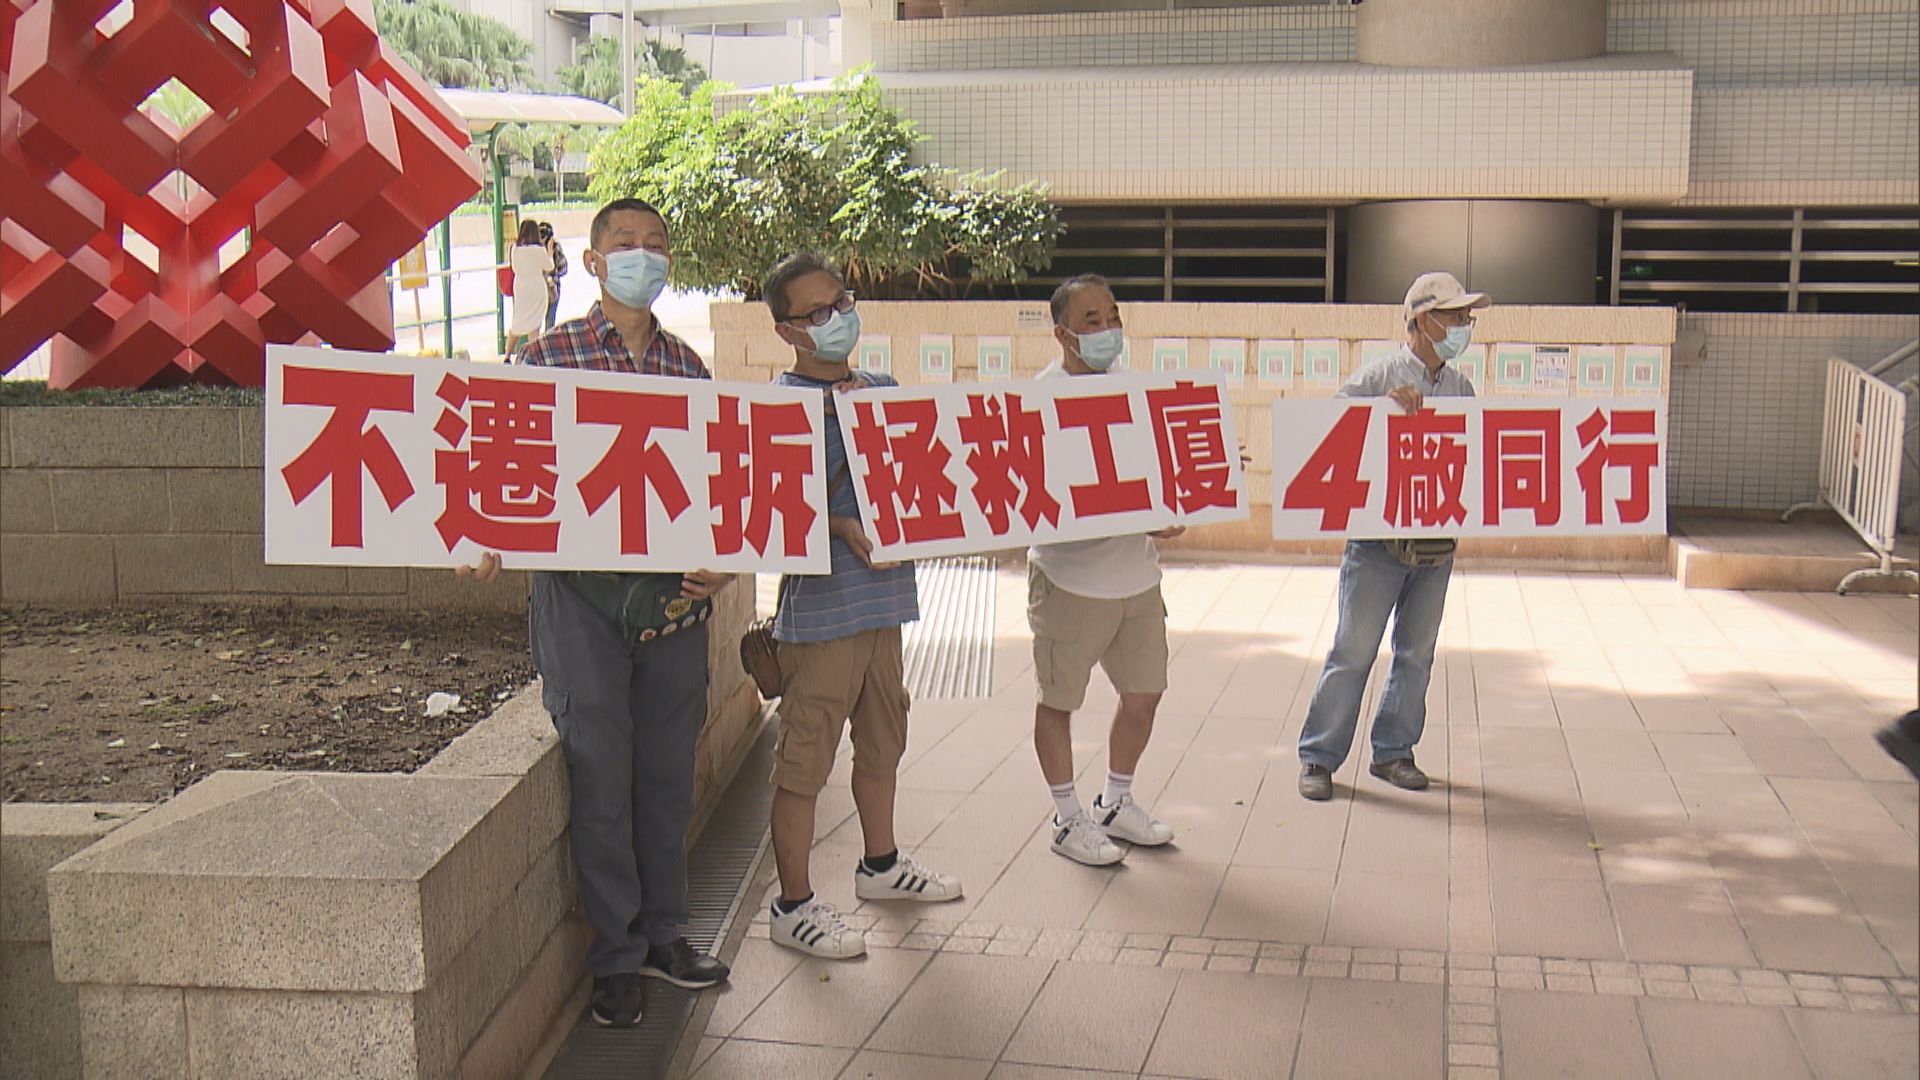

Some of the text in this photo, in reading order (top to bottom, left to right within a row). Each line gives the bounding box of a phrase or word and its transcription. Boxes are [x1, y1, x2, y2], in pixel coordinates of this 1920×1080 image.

[282, 365, 815, 556] 不遷不拆
[853, 382, 1237, 544] 拯救工廈
[1283, 406, 1658, 530] 4廠同行
